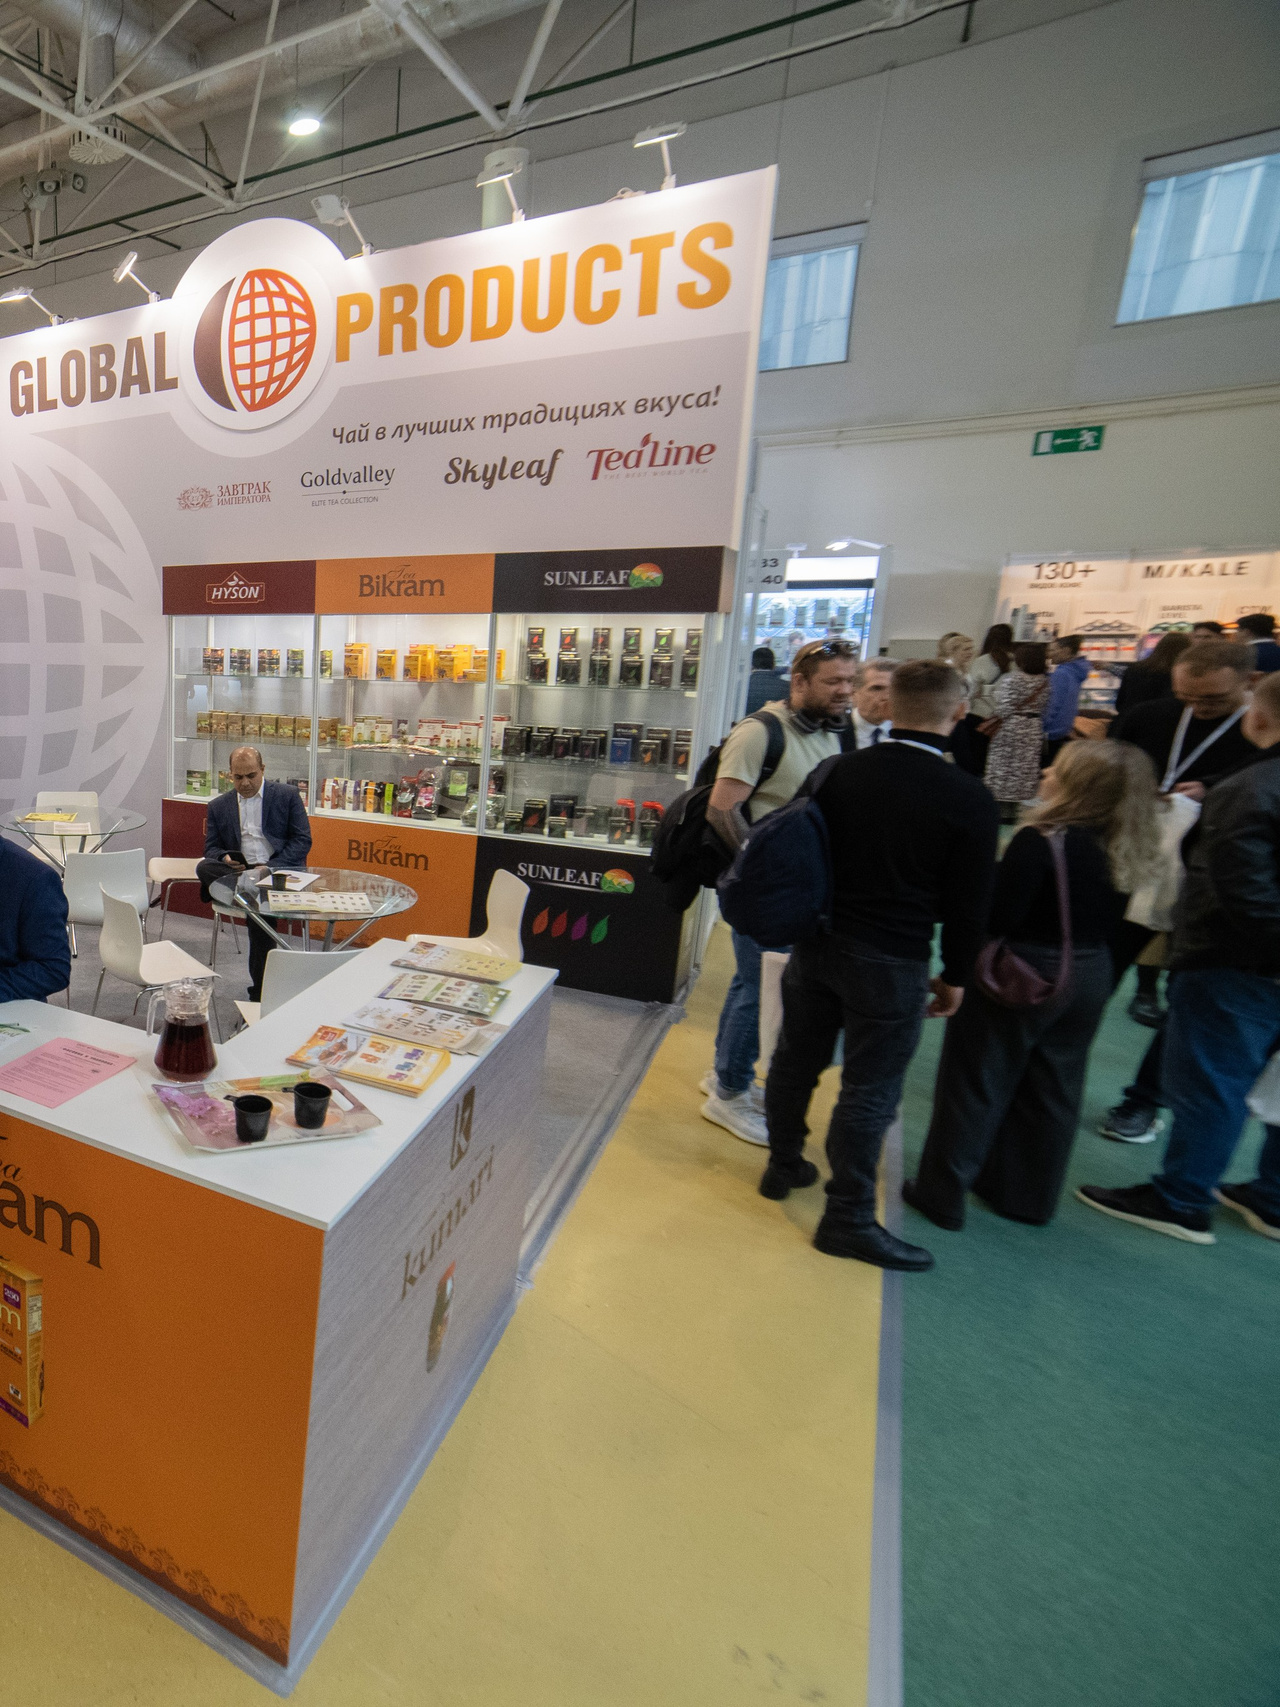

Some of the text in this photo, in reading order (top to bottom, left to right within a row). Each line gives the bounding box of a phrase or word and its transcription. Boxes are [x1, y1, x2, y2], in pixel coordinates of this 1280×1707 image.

[335, 221, 734, 363] PRODUCTS
[9, 331, 179, 417] GLOBAL
[332, 385, 722, 444] Чай в лучших традициях вкуса!
[300, 465, 396, 488] Goldvalley
[444, 448, 564, 490] Skyleaf
[217, 481, 271, 496] ЗАВТРАК
[217, 494, 271, 506] ИМПЕРАТОРА
[311, 499, 327, 507] ELITE
[340, 496, 379, 505] COLLECTION
[388, 564, 416, 579] Tea
[543, 570, 630, 586] SUNLEAF
[1034, 562, 1097, 580] 130+
[211, 586, 260, 600] HYSON
[359, 574, 445, 598] Bikram
[376, 835, 402, 850] Tea
[347, 839, 429, 871] Bikram
[517, 862, 603, 886] SUNLEAF
